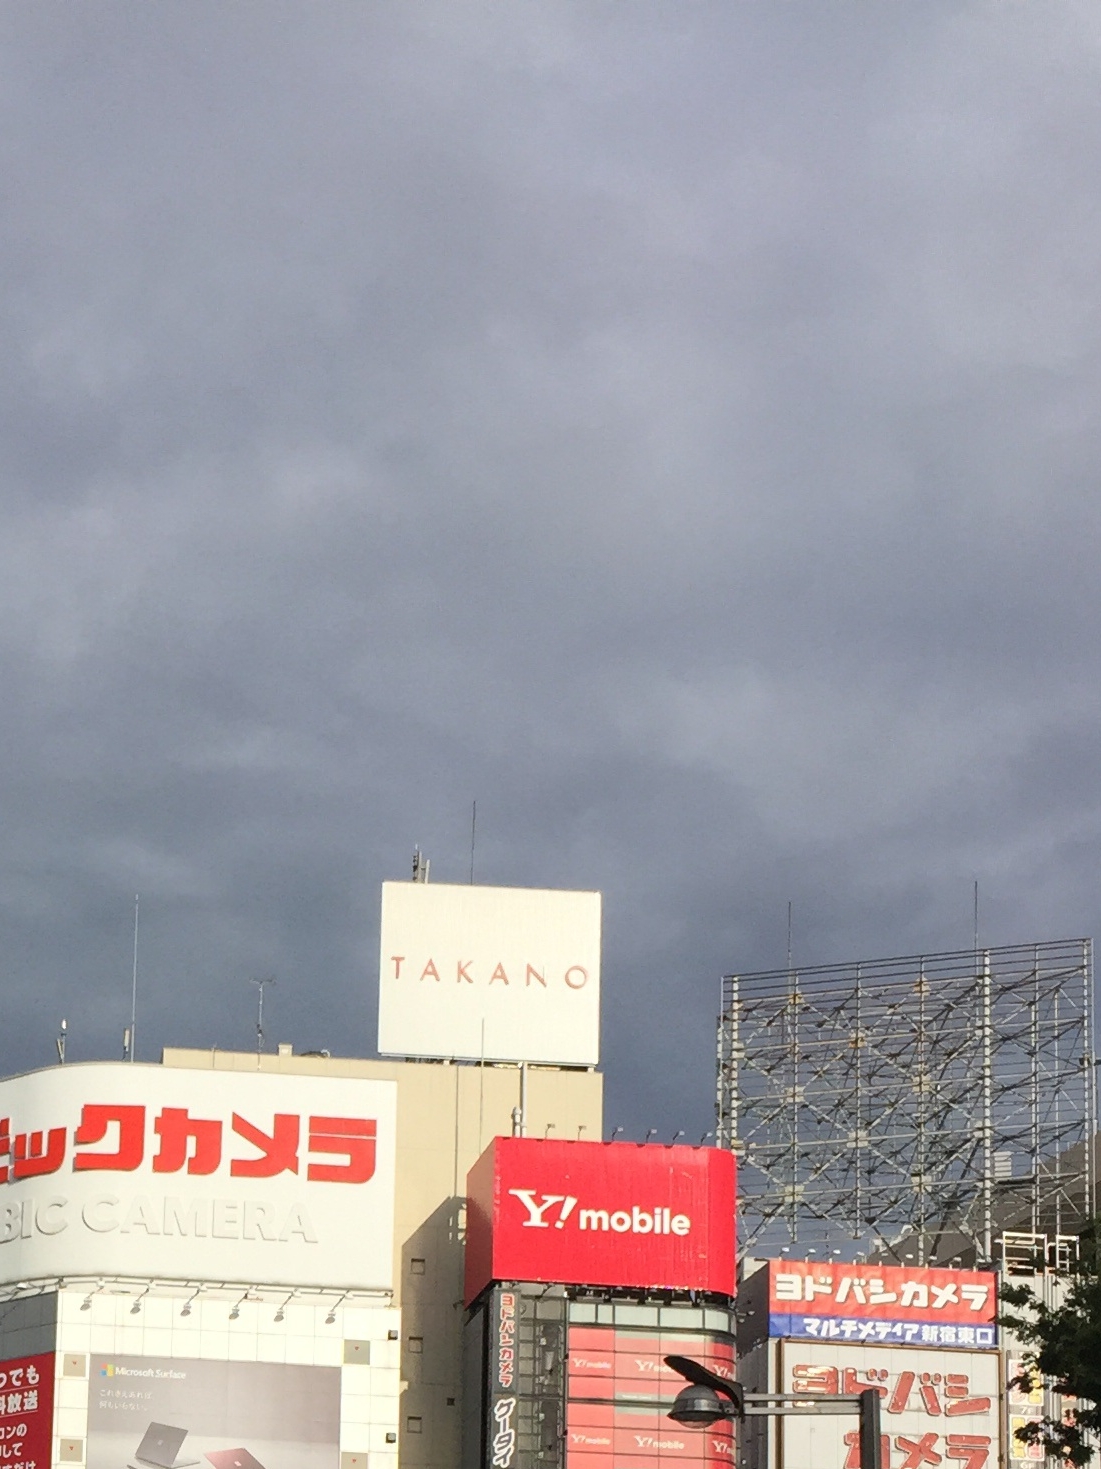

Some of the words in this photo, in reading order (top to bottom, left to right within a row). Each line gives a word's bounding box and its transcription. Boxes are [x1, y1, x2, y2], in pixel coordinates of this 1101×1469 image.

[391, 956, 588, 990] TAKANO
[81, 1196, 319, 1244] CAMERA
[775, 1273, 990, 1311] ヨドバシカメラ
[498, 1293, 515, 1388] ヨドバシカメラ
[803, 1318, 993, 1345] マルチメディア新宿東口
[115, 1367, 154, 1377] Microsoft
[155, 1369, 186, 1380] Surface
[792, 1365, 992, 1417] ヨドバシ
[492, 1398, 515, 1468] ケータイ
